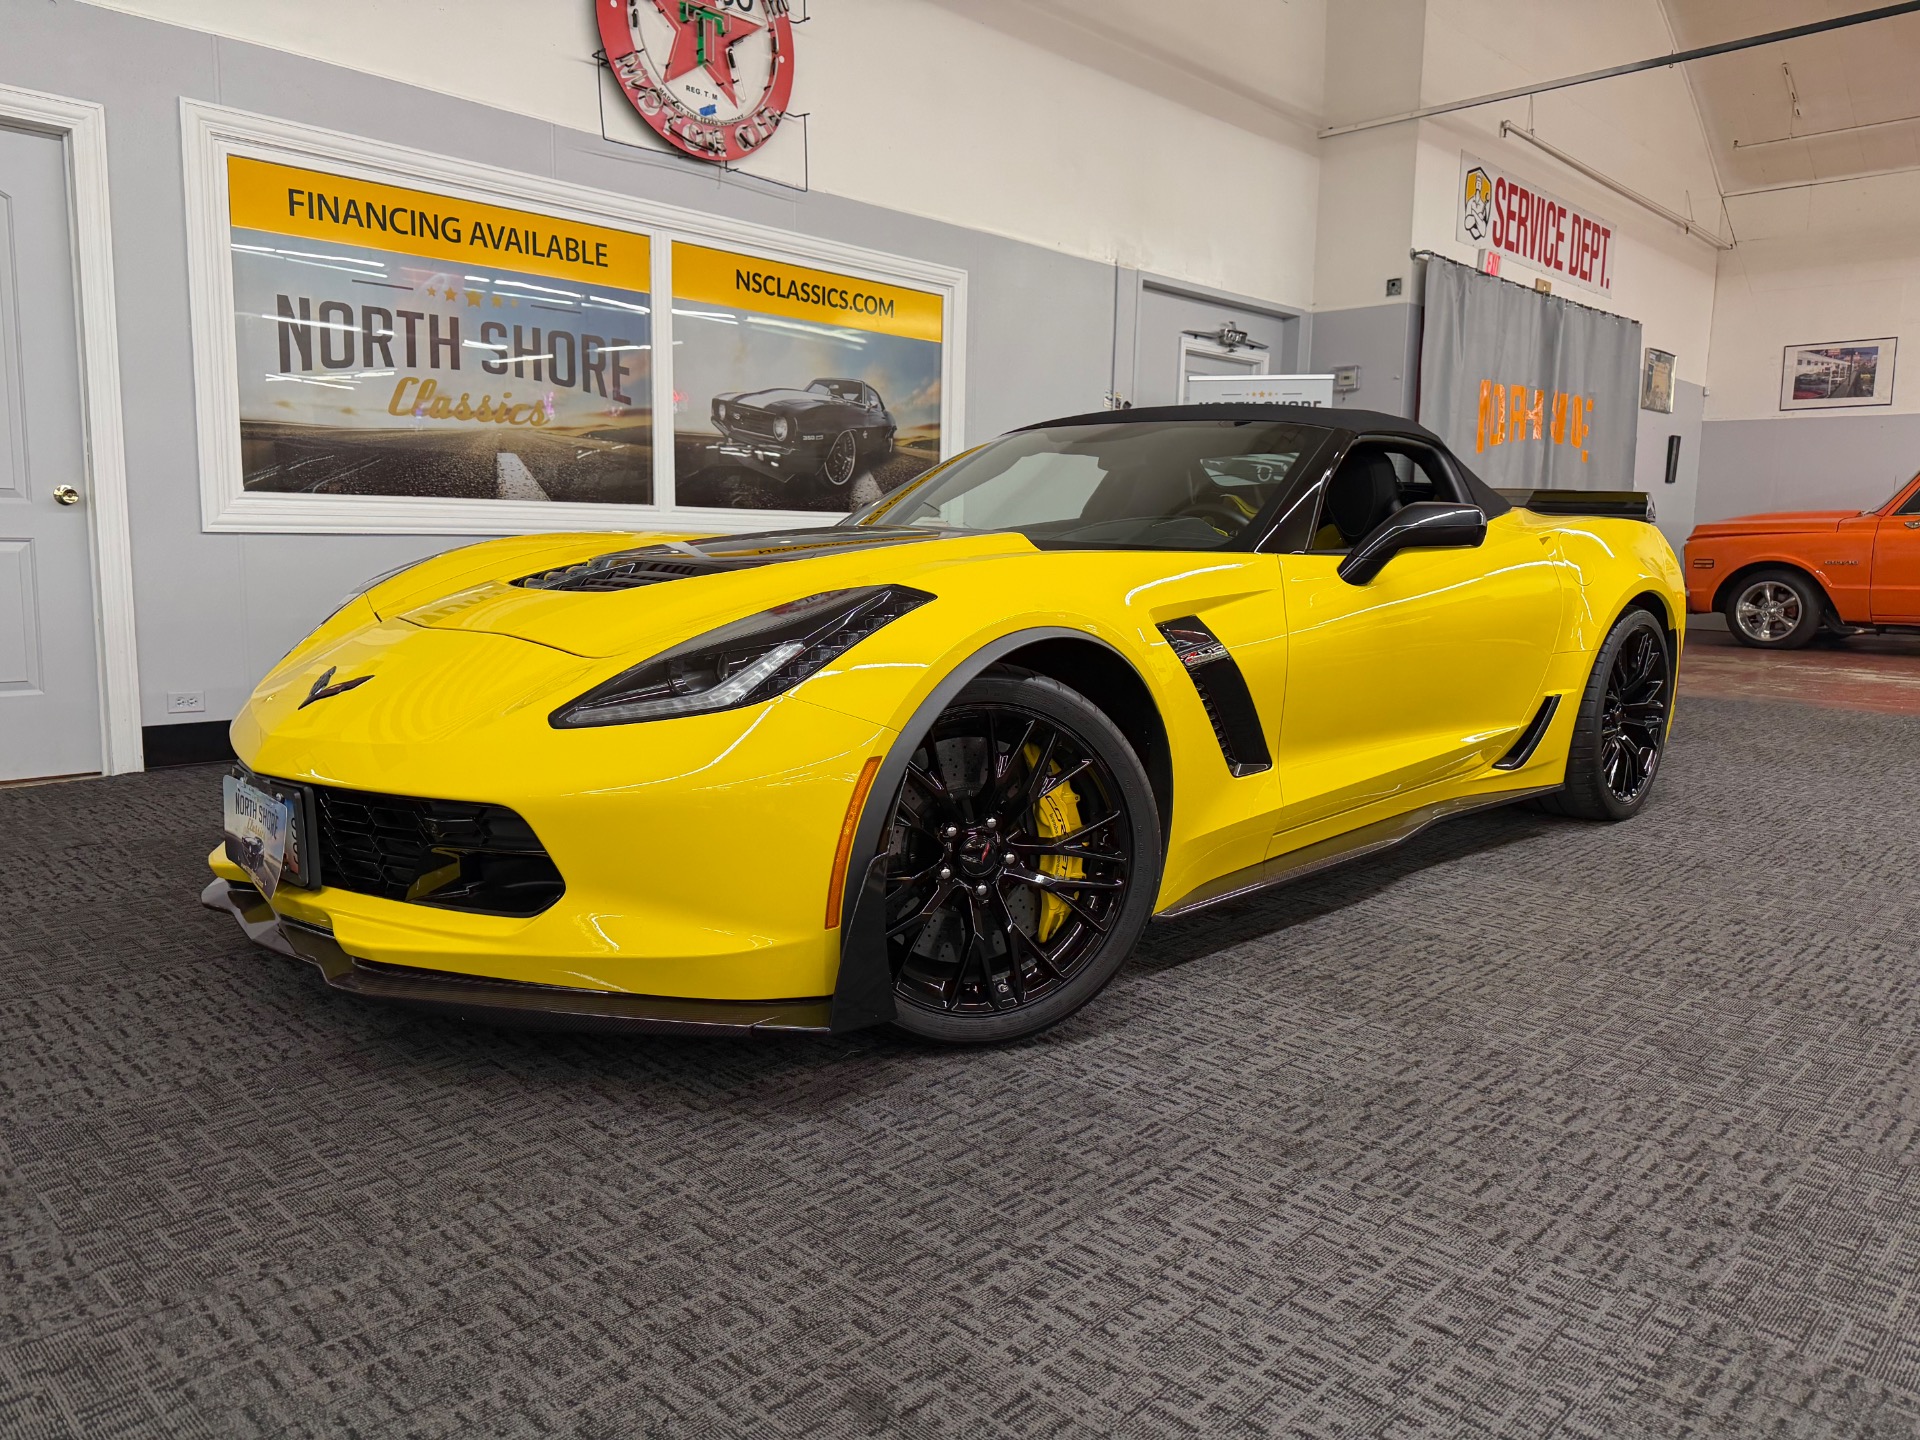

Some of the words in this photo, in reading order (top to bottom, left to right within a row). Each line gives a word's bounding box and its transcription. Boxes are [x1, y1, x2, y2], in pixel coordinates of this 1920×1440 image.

[614, 53, 727, 157] MOTOR
[686, 111, 698, 121] THE
[287, 188, 462, 244] FINANCING
[469, 222, 609, 268] AVAILABLE
[1492, 176, 1567, 271] SERVICE
[1568, 213, 1611, 290] DEPT.
[735, 269, 895, 318] NSCLASSICS.COM
[276, 294, 461, 373] NORTH
[480, 321, 632, 406] SHORE
[387, 377, 551, 427] Classics
[235, 791, 258, 820] NORTH
[258, 805, 279, 841] SHORE
